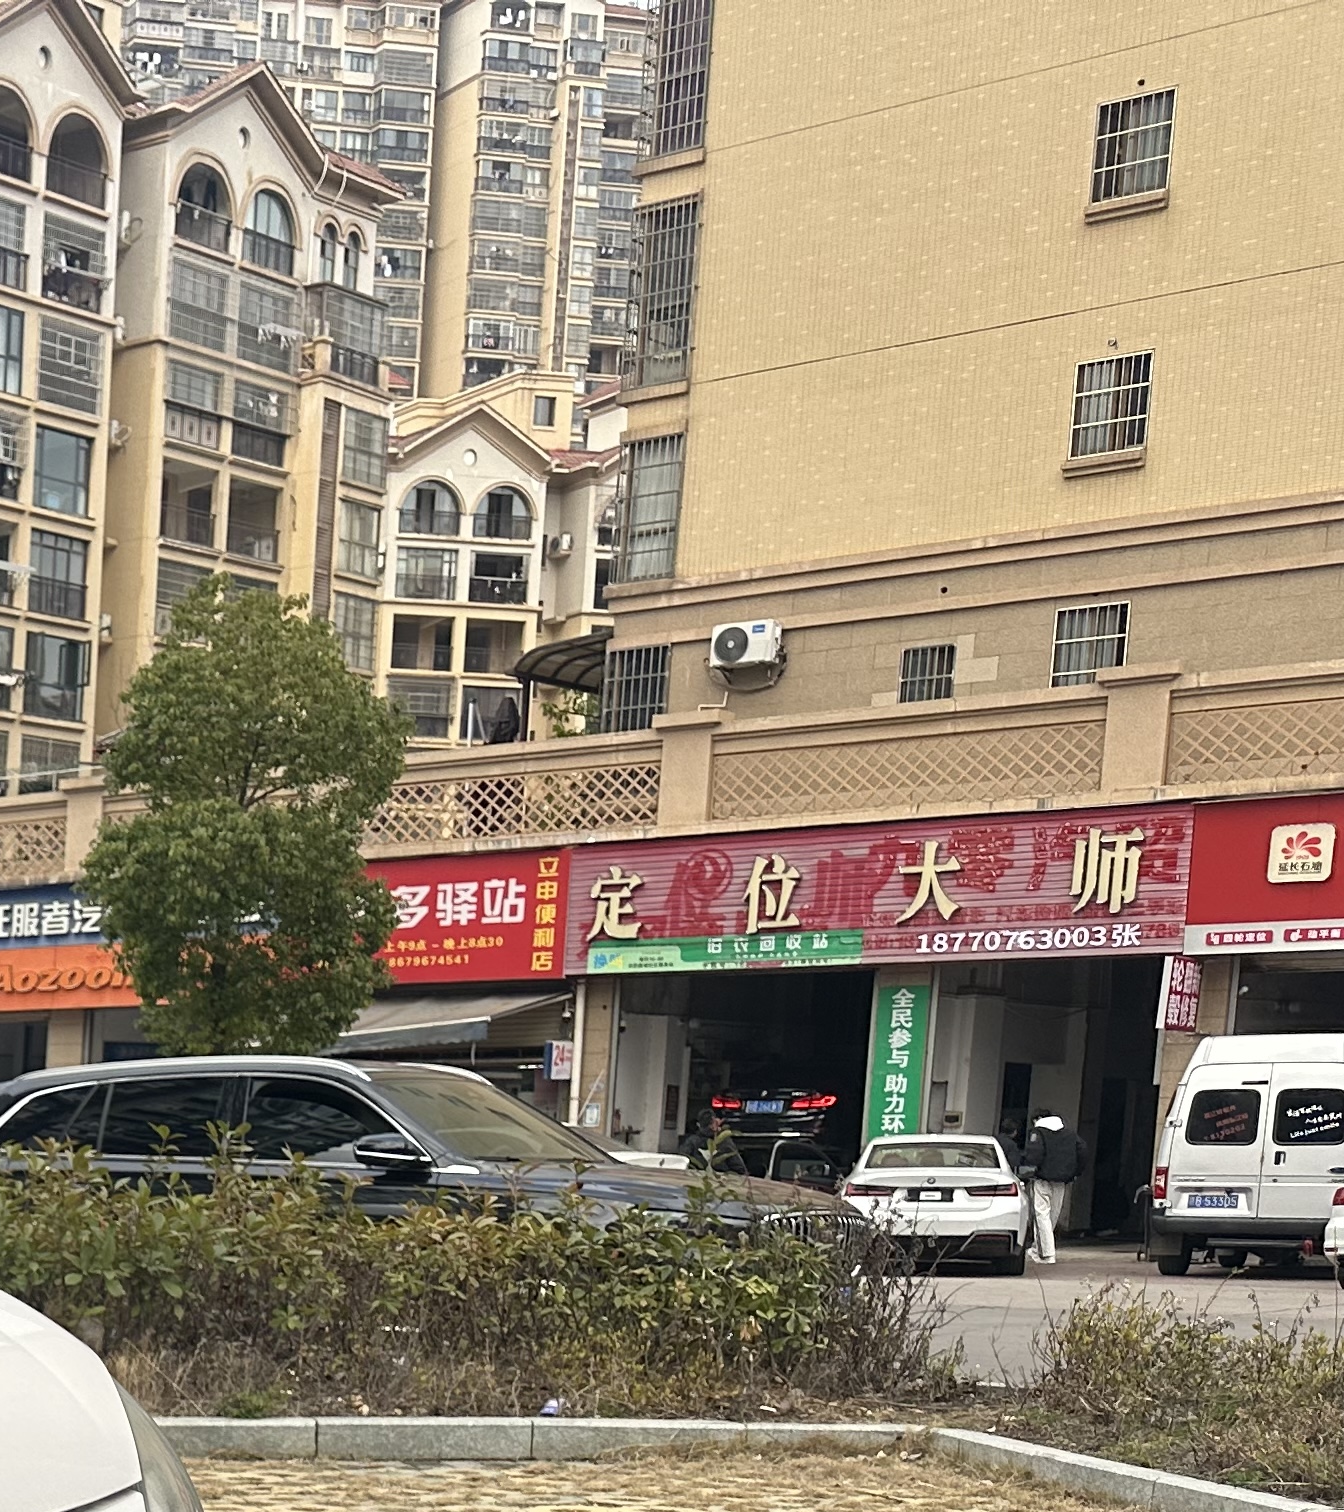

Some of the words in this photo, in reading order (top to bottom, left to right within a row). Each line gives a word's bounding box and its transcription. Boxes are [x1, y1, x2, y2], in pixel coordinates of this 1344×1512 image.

[388, 877, 527, 929] 多驿站
[587, 827, 1145, 941] 定位大师
[387, 954, 469, 968] 8679674541
[887, 988, 915, 1068] 全民参与
[880, 1073, 908, 1138] 助力环
